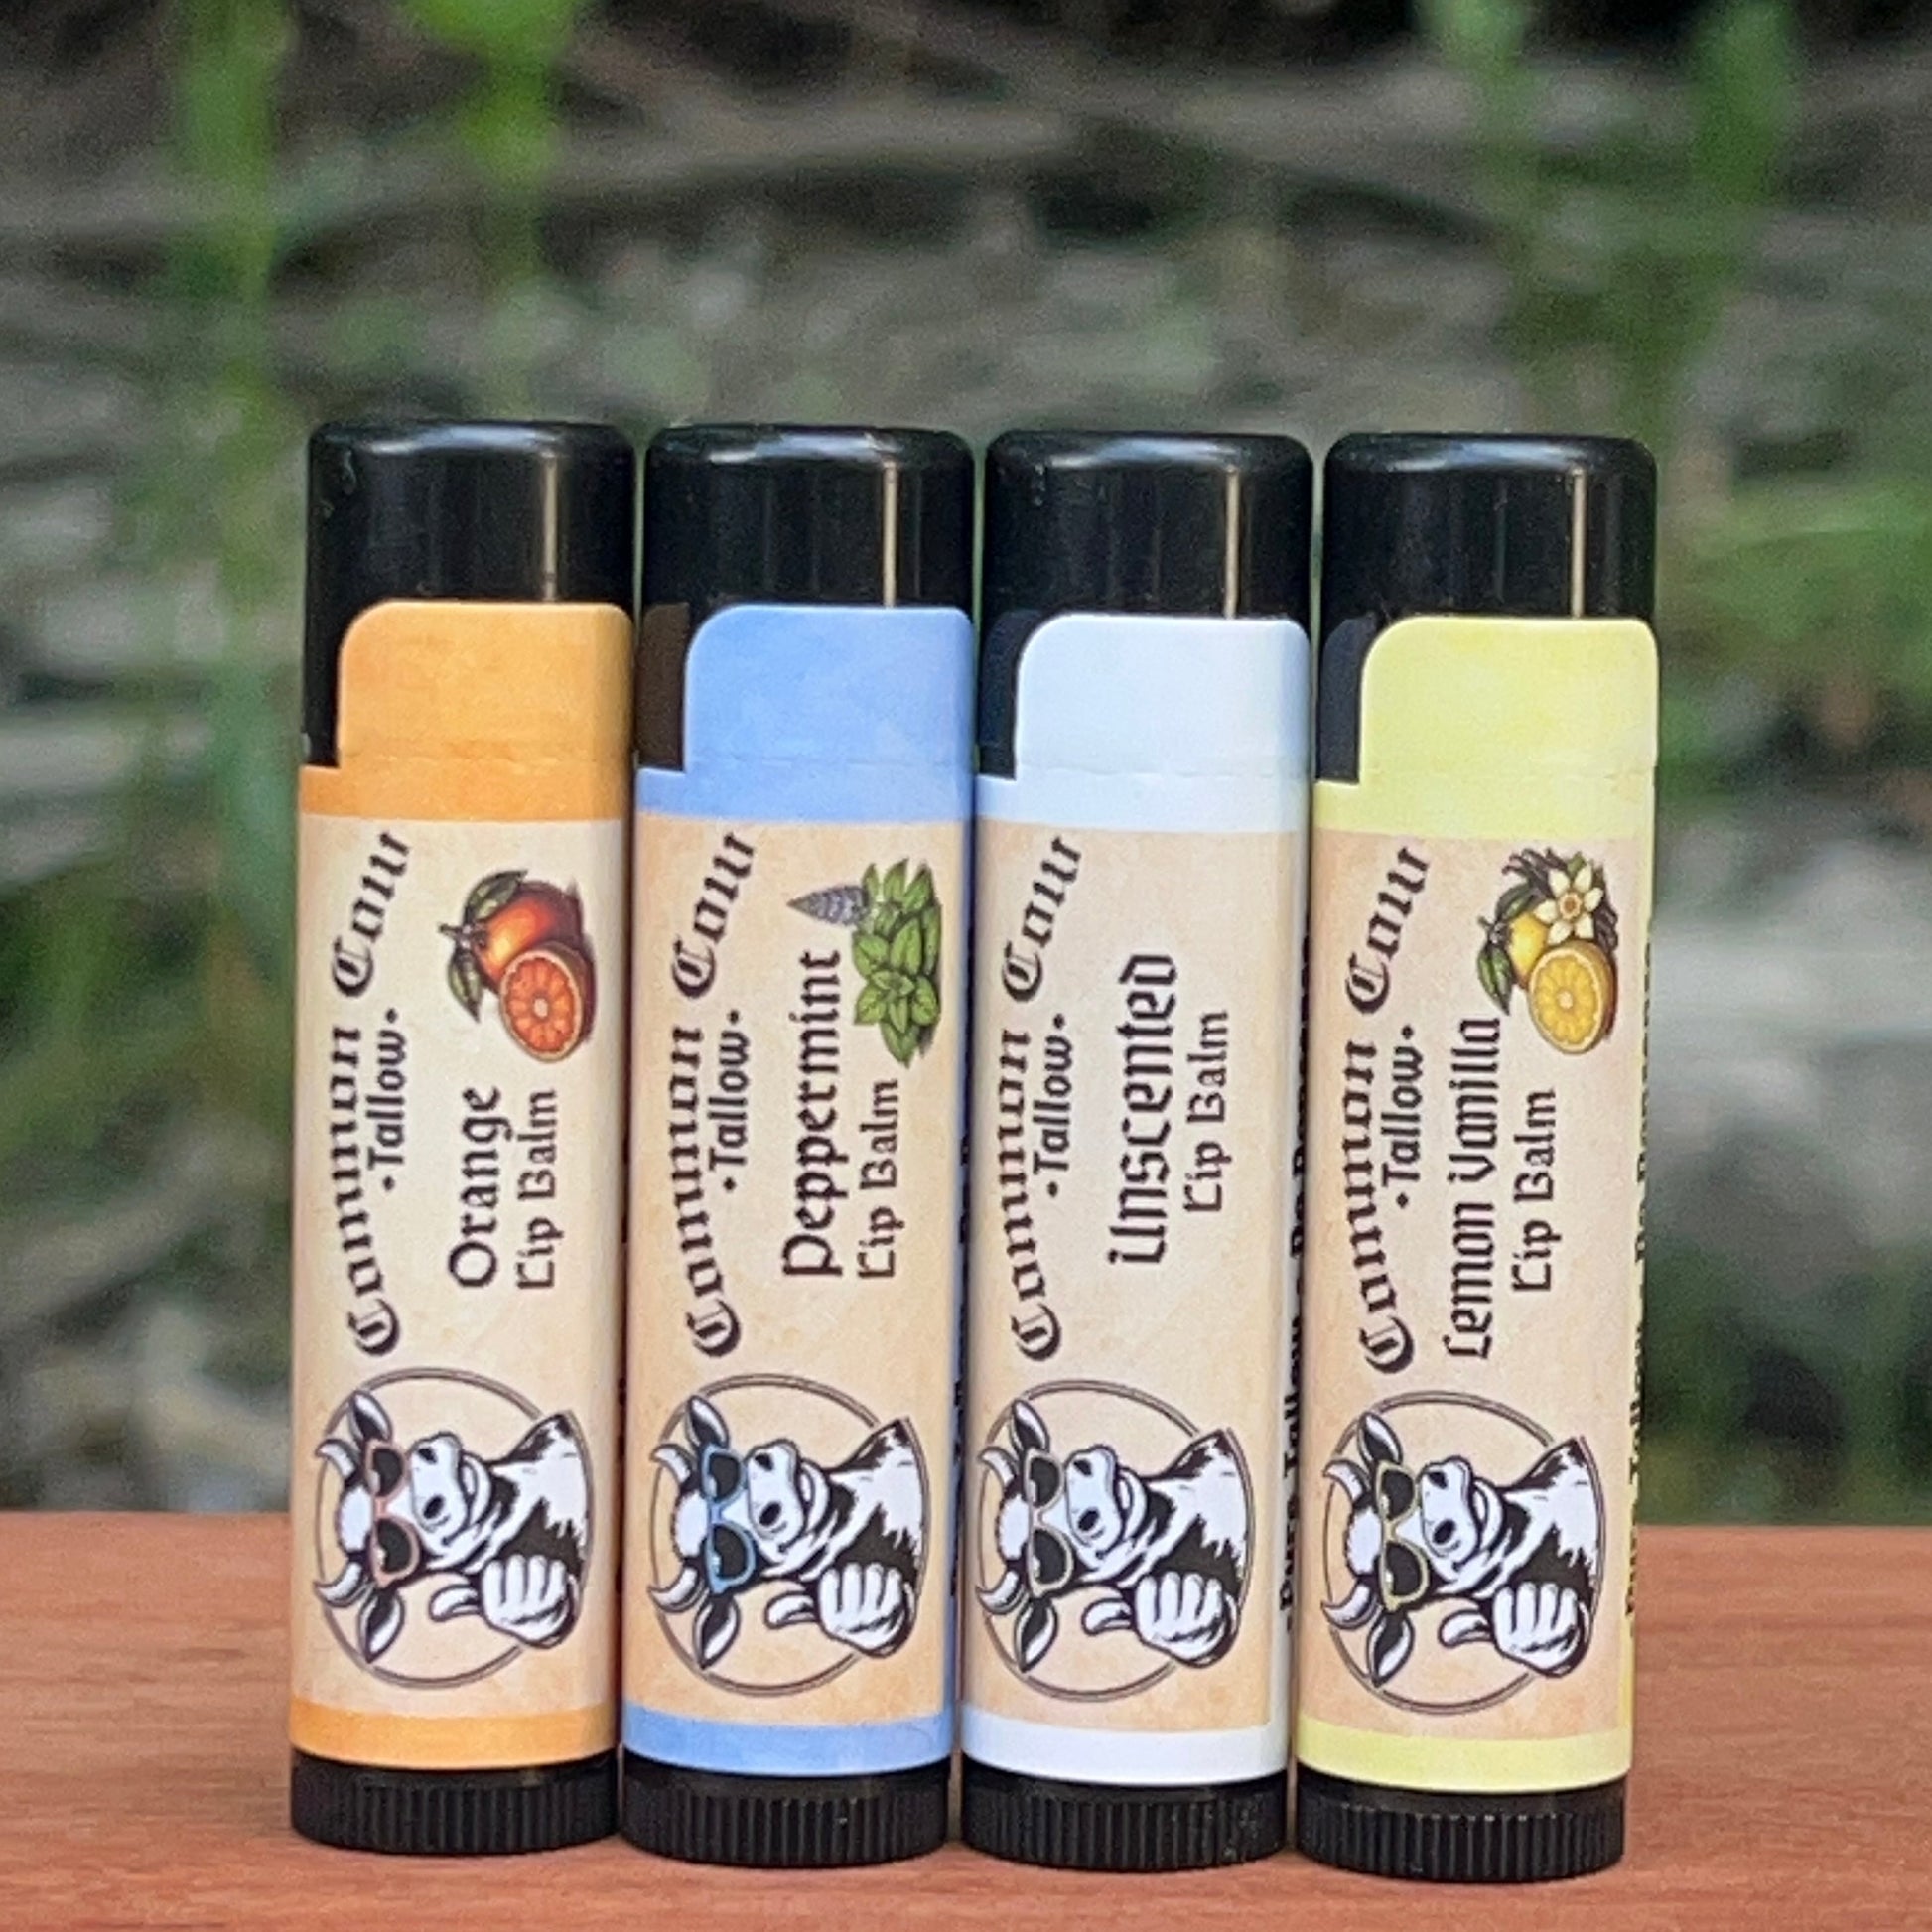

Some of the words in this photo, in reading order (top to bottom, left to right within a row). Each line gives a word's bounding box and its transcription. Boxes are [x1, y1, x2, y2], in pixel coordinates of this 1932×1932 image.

[331, 832, 409, 998] Cow
[671, 832, 755, 1000] Cow
[1001, 836, 1081, 1003] Cow
[1344, 847, 1429, 1015] Cow
[516, 1090, 557, 1201] Balm
[780, 950, 850, 1277] Peppermint
[859, 1079, 899, 1190] Balm
[1107, 954, 1177, 1265] Unscented
[1185, 1011, 1229, 1124] Balm
[1447, 1017, 1501, 1183] Vanilla
[1512, 1089, 1556, 1203] Balm
[329, 1027, 400, 1357] Common
[447, 1087, 513, 1289] Orange
[516, 1216, 564, 1290] Lip
[668, 1026, 742, 1358] Common
[856, 1206, 905, 1280] Lip
[997, 1029, 1062, 1362] Common
[1182, 1141, 1233, 1213] Lip
[1341, 1040, 1415, 1375] Common
[1510, 1219, 1563, 1292] Lip
[1442, 1202, 1495, 1360] Lemon
